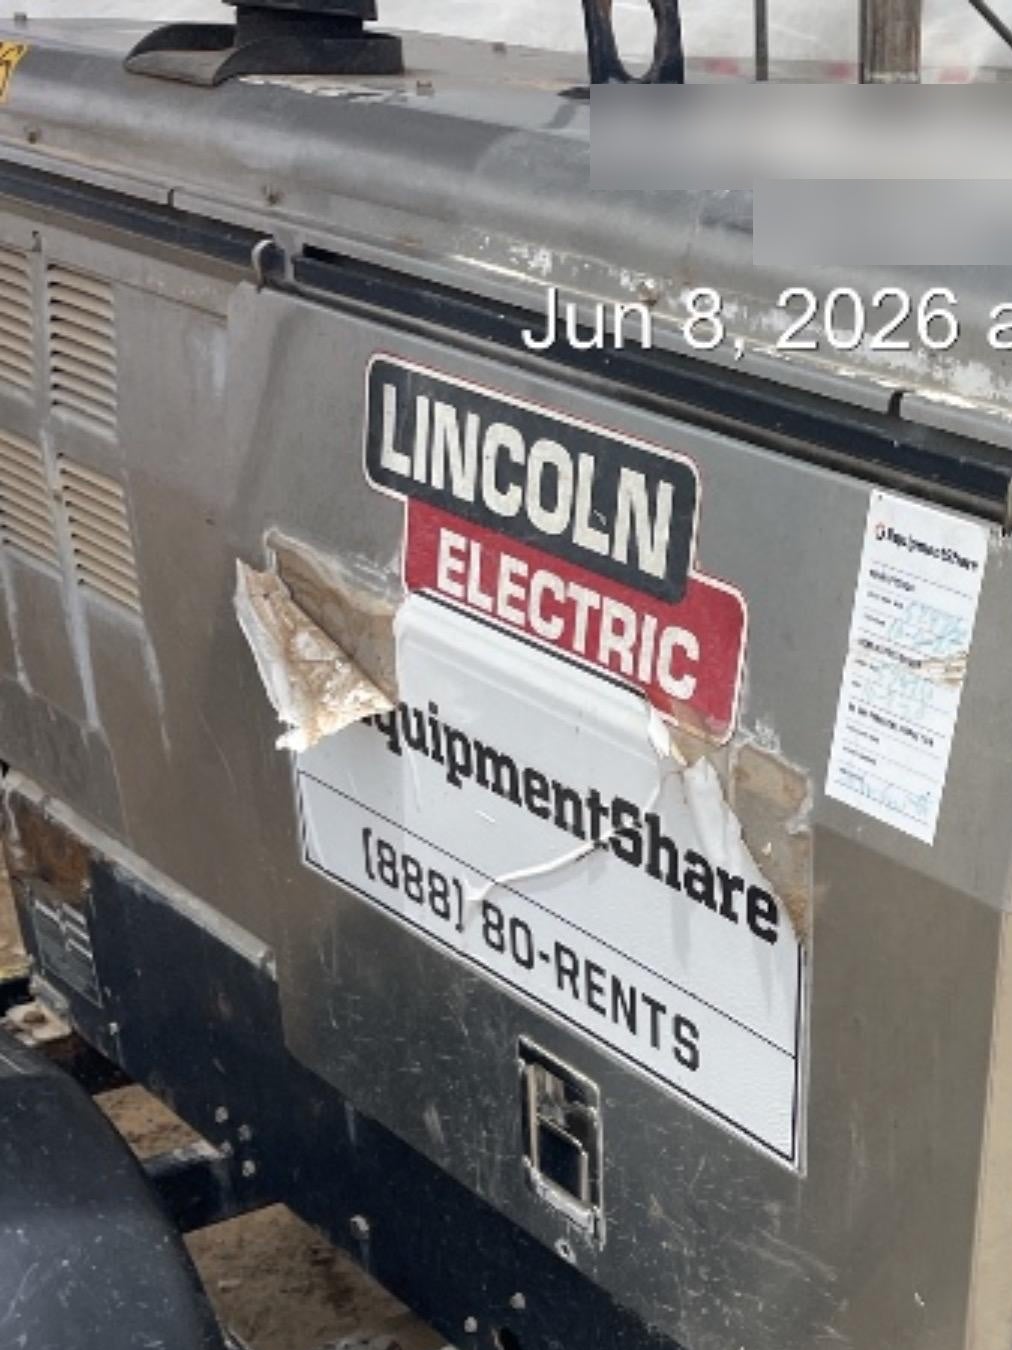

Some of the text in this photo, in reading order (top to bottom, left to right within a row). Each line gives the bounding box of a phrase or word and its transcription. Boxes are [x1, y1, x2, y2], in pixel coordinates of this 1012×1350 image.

[379, 384, 675, 580] LINCOLN
[436, 526, 701, 701] ELECTRIC
[361, 698, 780, 947] quipmentShare
[360, 826, 702, 1074] (888) 80-RENTS
